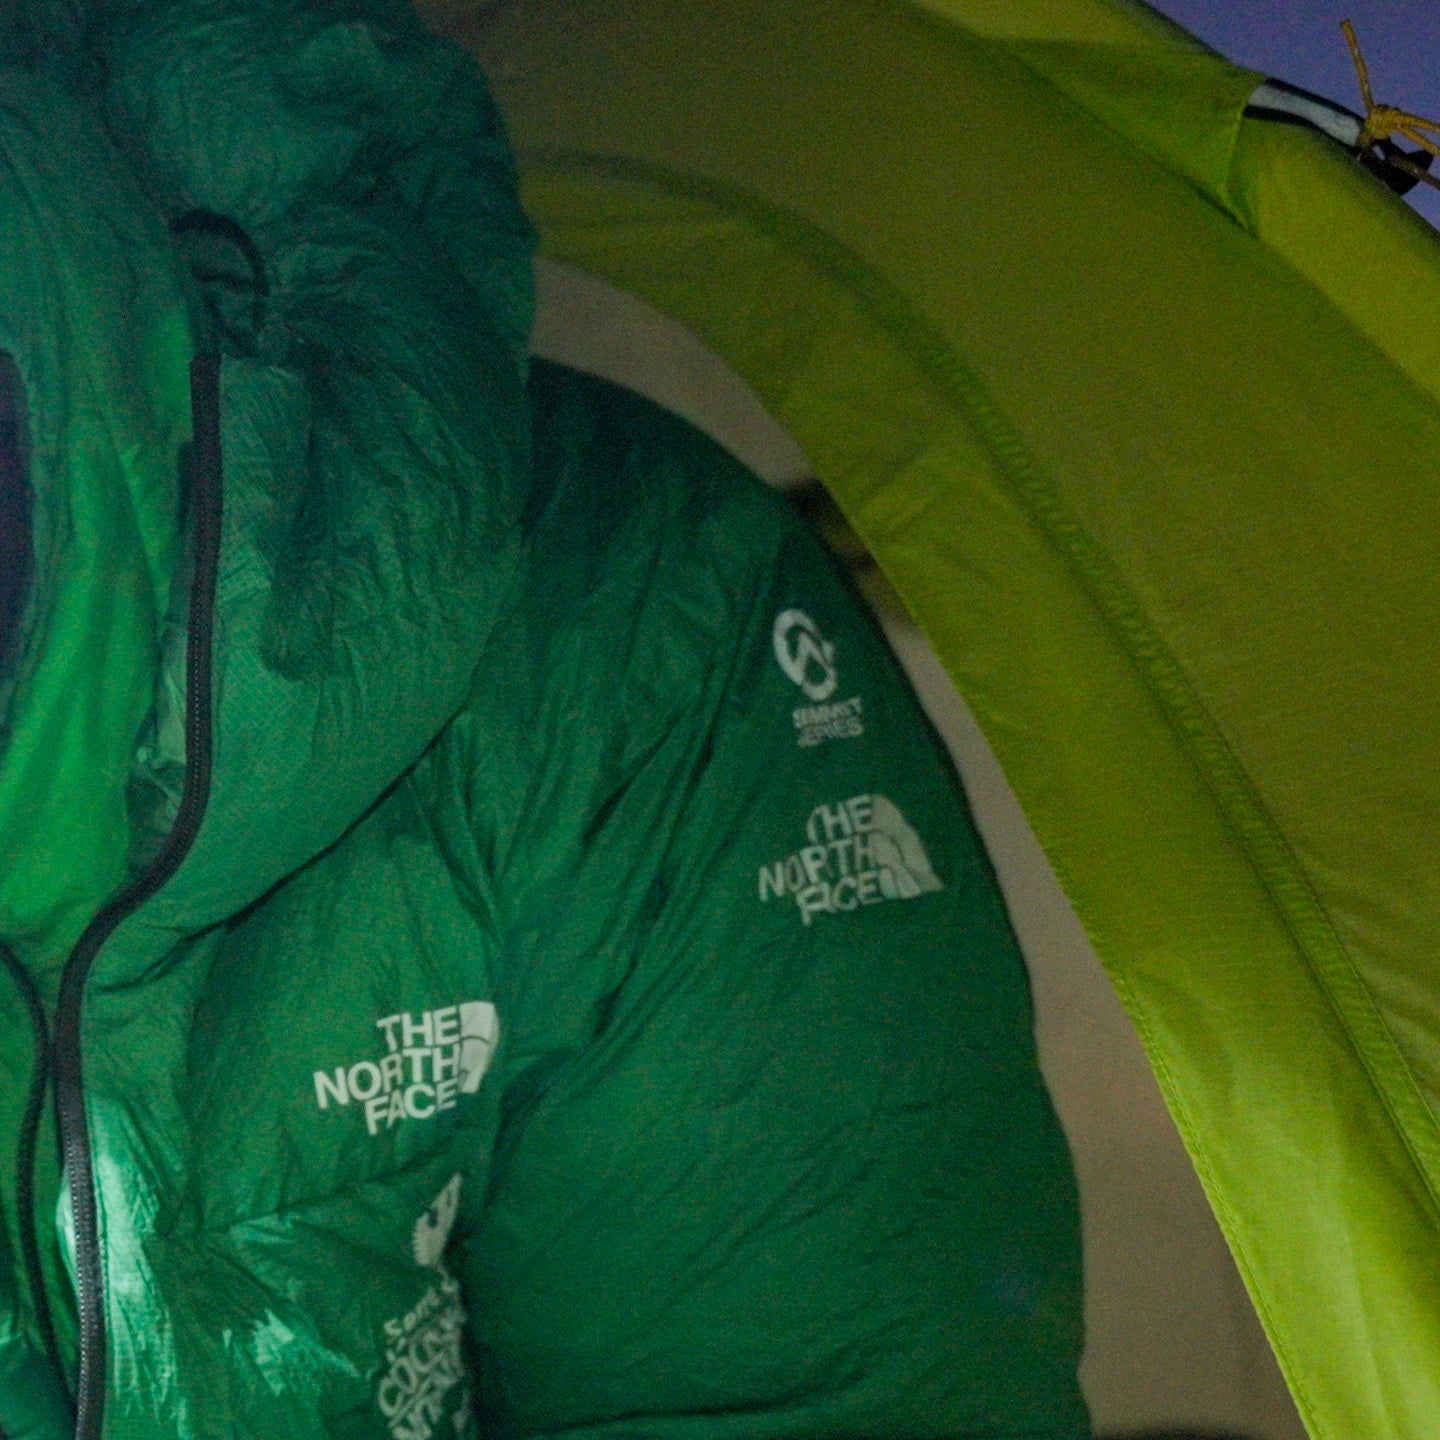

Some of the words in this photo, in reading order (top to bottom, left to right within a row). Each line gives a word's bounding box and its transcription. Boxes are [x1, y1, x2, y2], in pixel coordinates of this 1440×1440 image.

[758, 834, 879, 901] NORTH
[375, 1006, 460, 1052] THE
[312, 1044, 460, 1110] NORTH
[364, 1078, 457, 1136] FACE
